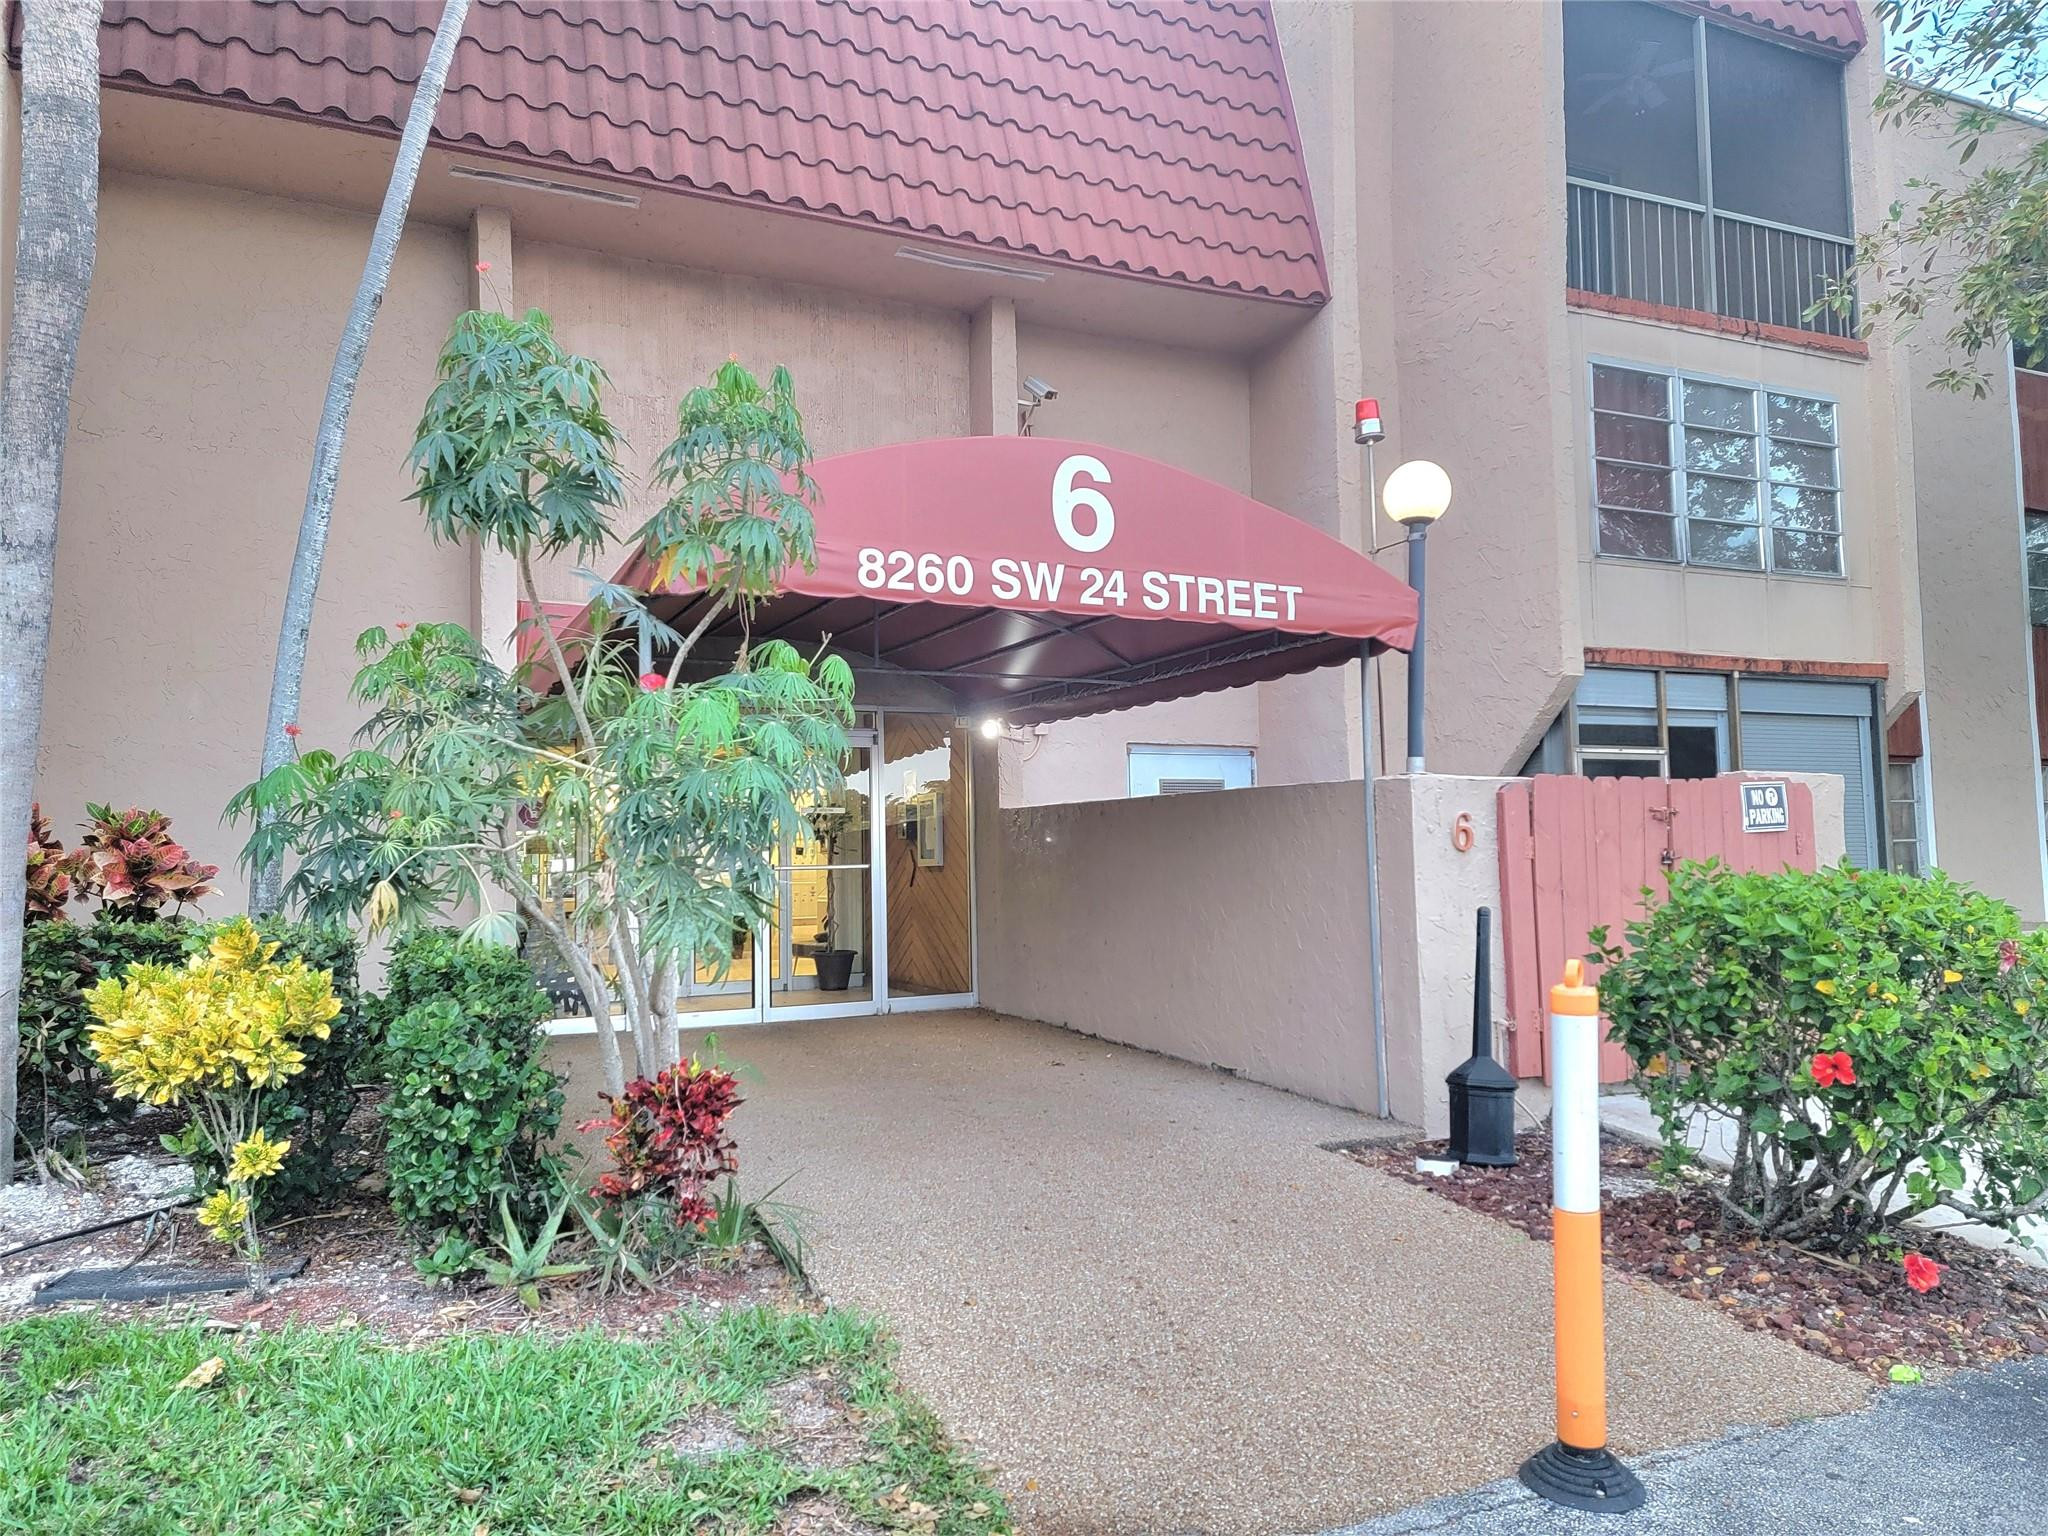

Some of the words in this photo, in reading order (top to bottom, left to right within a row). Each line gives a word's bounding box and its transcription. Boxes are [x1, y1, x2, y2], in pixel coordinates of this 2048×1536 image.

[1052, 454, 1115, 553] 6
[857, 548, 974, 596] 8260
[991, 558, 1066, 602] SW
[1079, 567, 1128, 607] 24
[1142, 570, 1304, 622] STREET
[1748, 808, 1785, 825] PARKING
[1750, 789, 1764, 806] NO
[1454, 811, 1473, 852] 6
